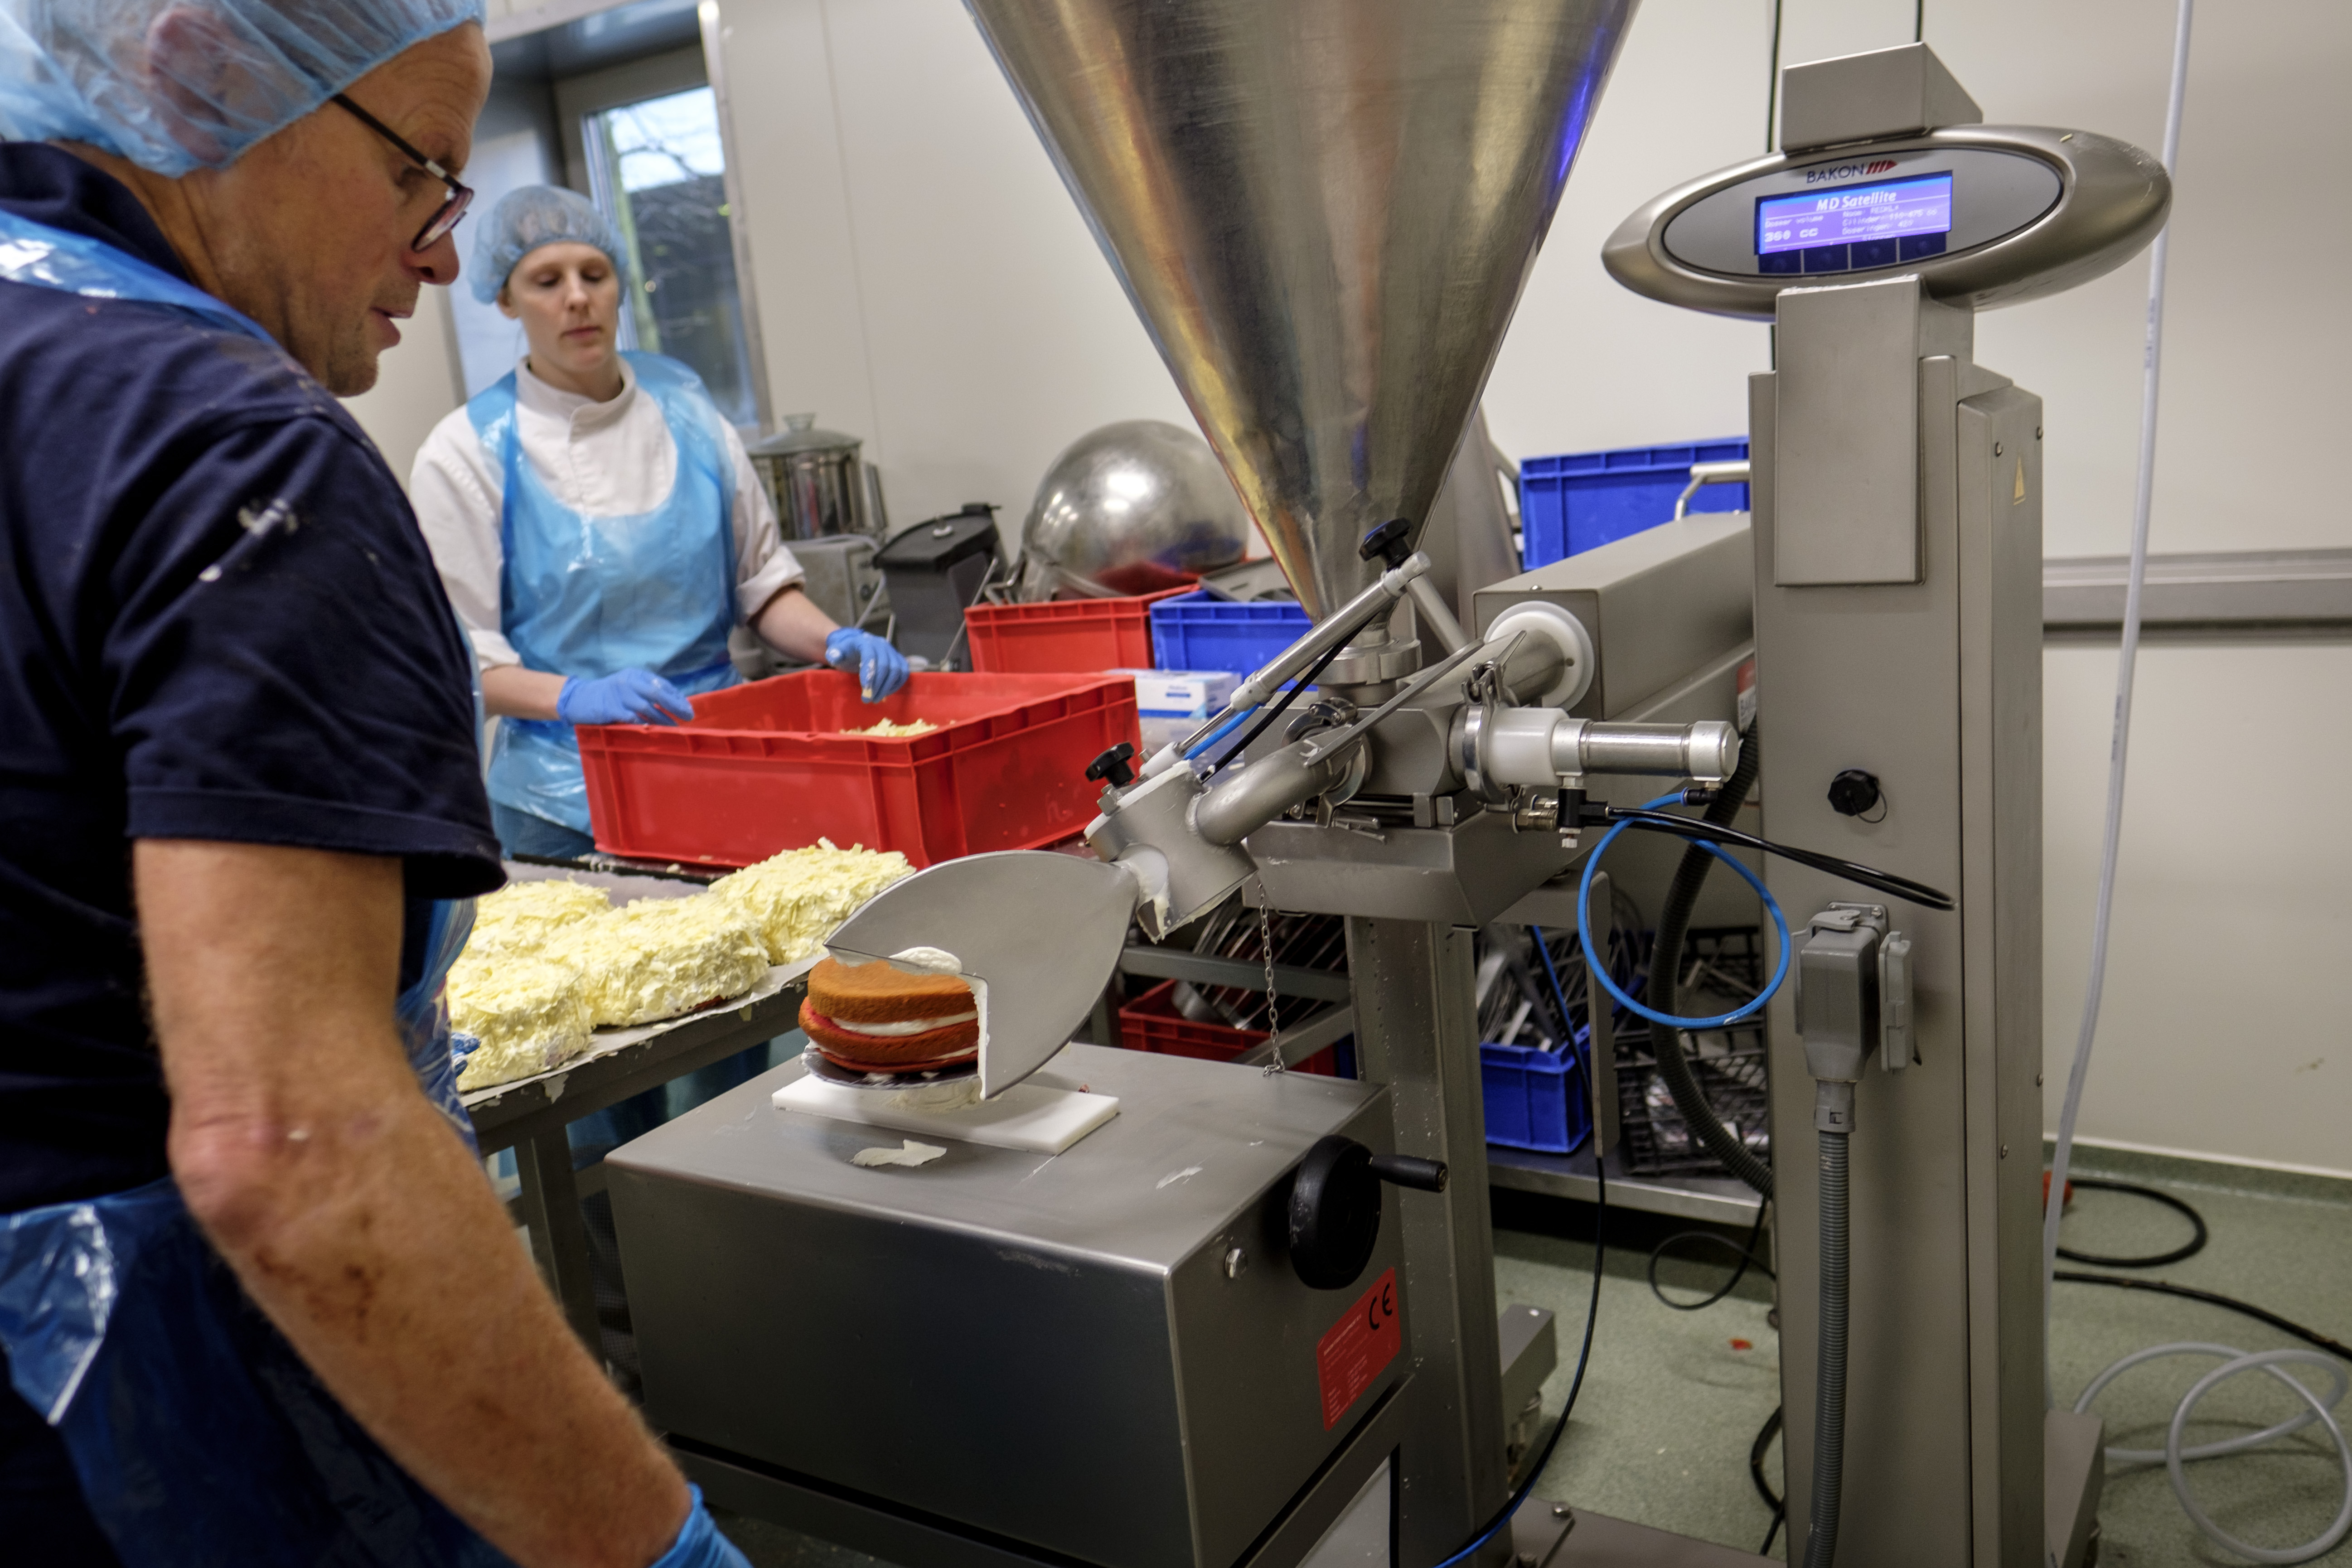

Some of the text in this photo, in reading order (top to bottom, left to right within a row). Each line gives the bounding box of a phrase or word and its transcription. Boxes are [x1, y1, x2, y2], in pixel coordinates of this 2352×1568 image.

[1806, 164, 1865, 184] BAKON
[1816, 190, 1897, 211] MD Satellite
[1369, 1282, 1393, 1331] CE
